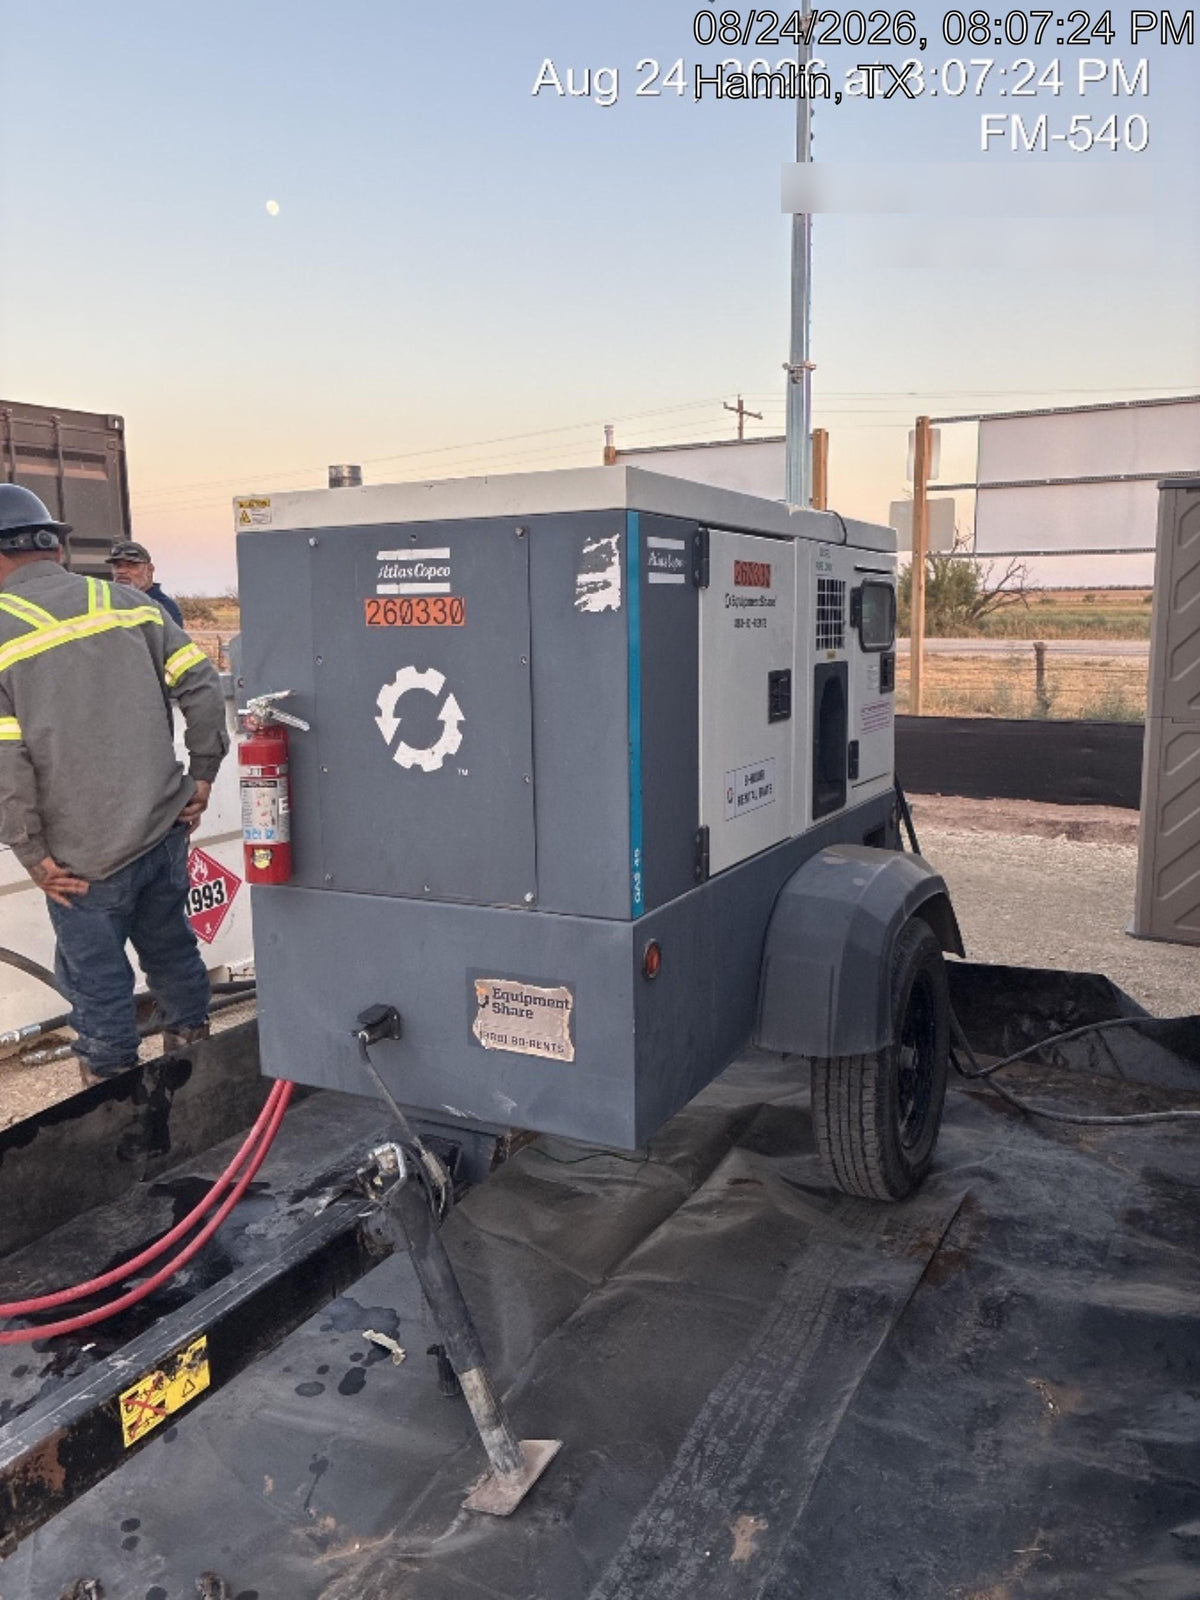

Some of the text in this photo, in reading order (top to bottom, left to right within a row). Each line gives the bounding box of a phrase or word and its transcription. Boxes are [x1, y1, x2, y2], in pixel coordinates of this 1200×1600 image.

[367, 598, 463, 625] 260330
[185, 879, 225, 917] 1993
[491, 1001, 534, 1019] Share
[492, 986, 570, 1010] Equipment
